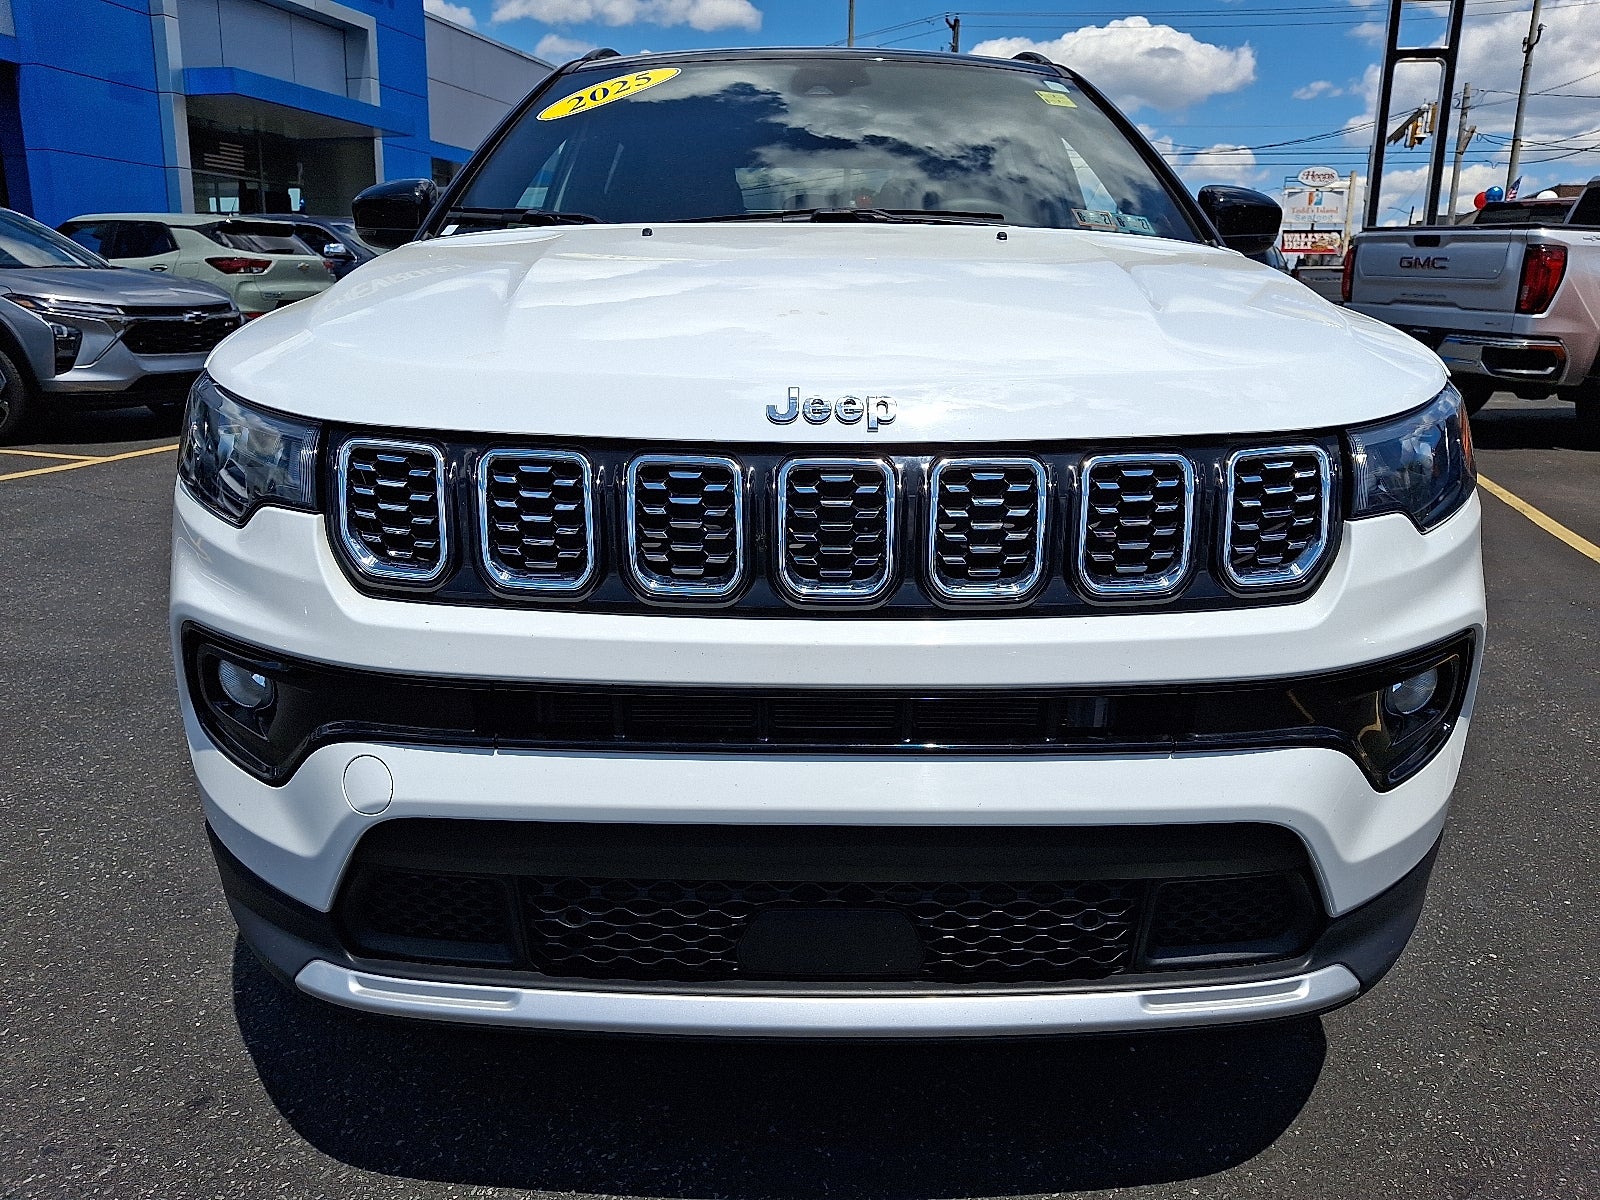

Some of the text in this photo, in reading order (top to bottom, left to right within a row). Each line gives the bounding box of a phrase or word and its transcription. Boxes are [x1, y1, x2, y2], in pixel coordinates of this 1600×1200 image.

[567, 72, 652, 112] 2025
[1399, 256, 1449, 269] GMC
[765, 387, 898, 432] Jeep
